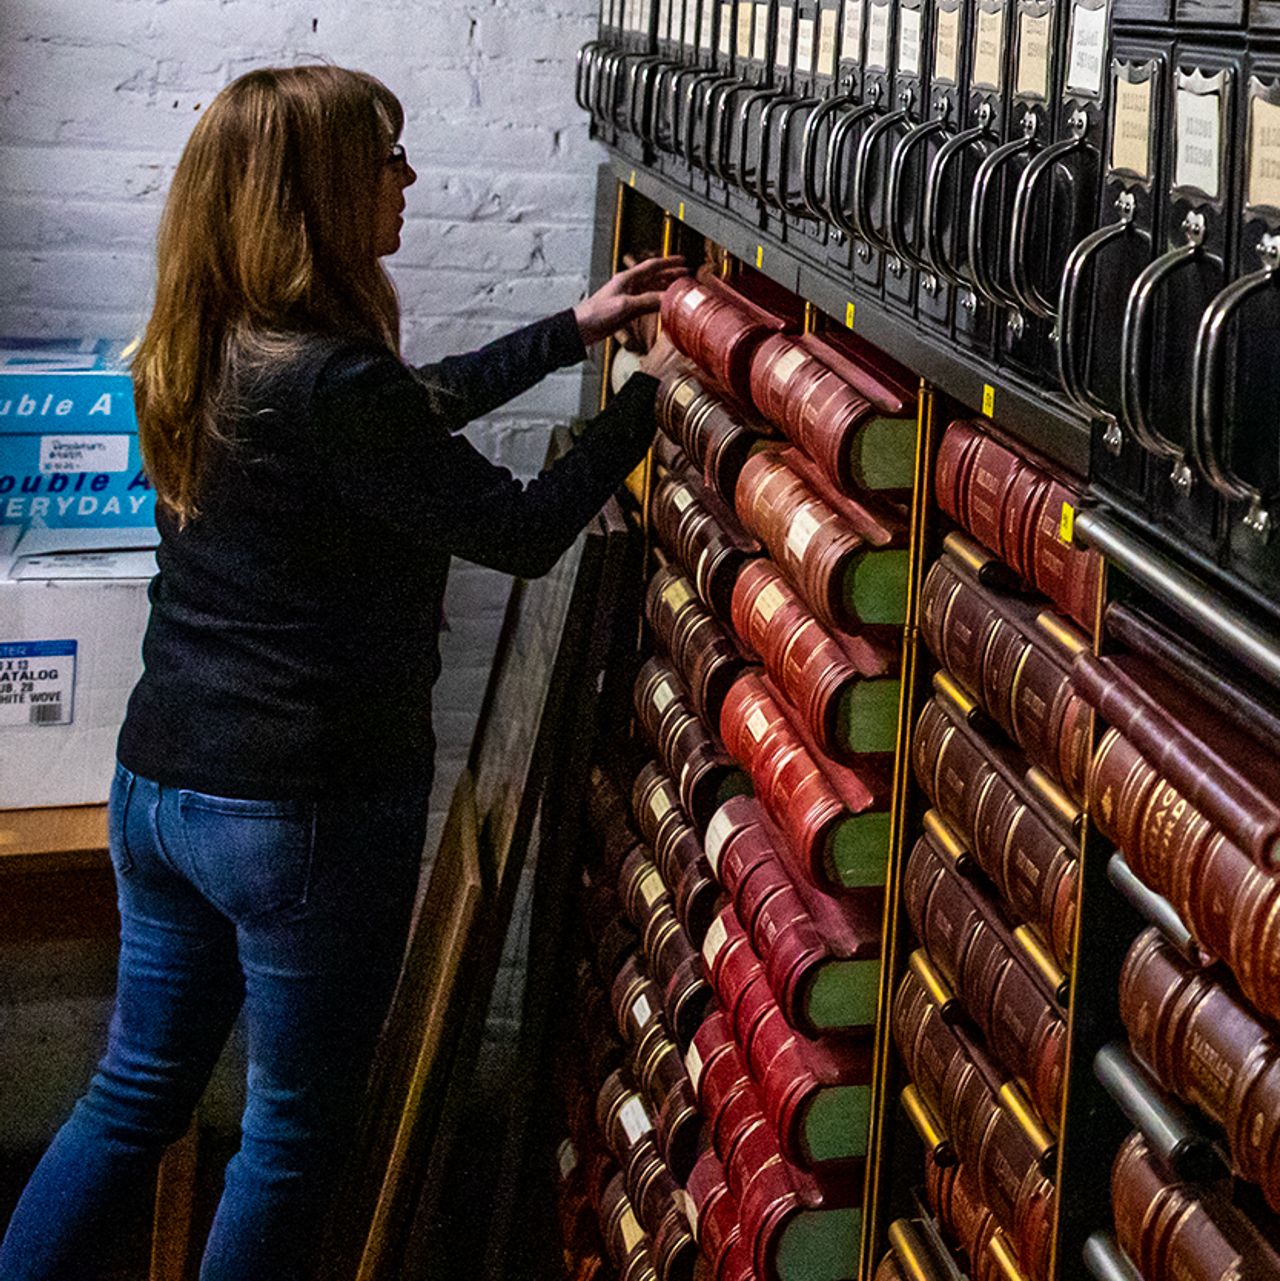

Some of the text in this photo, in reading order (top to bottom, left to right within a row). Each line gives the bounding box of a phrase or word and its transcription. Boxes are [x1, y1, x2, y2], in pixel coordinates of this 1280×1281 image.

[88, 393, 112, 415] A
[127, 470, 151, 491] A
[0, 496, 146, 517] ERYDAY
[0, 669, 59, 682] ATALOG
[30, 691, 62, 703] WOVE
